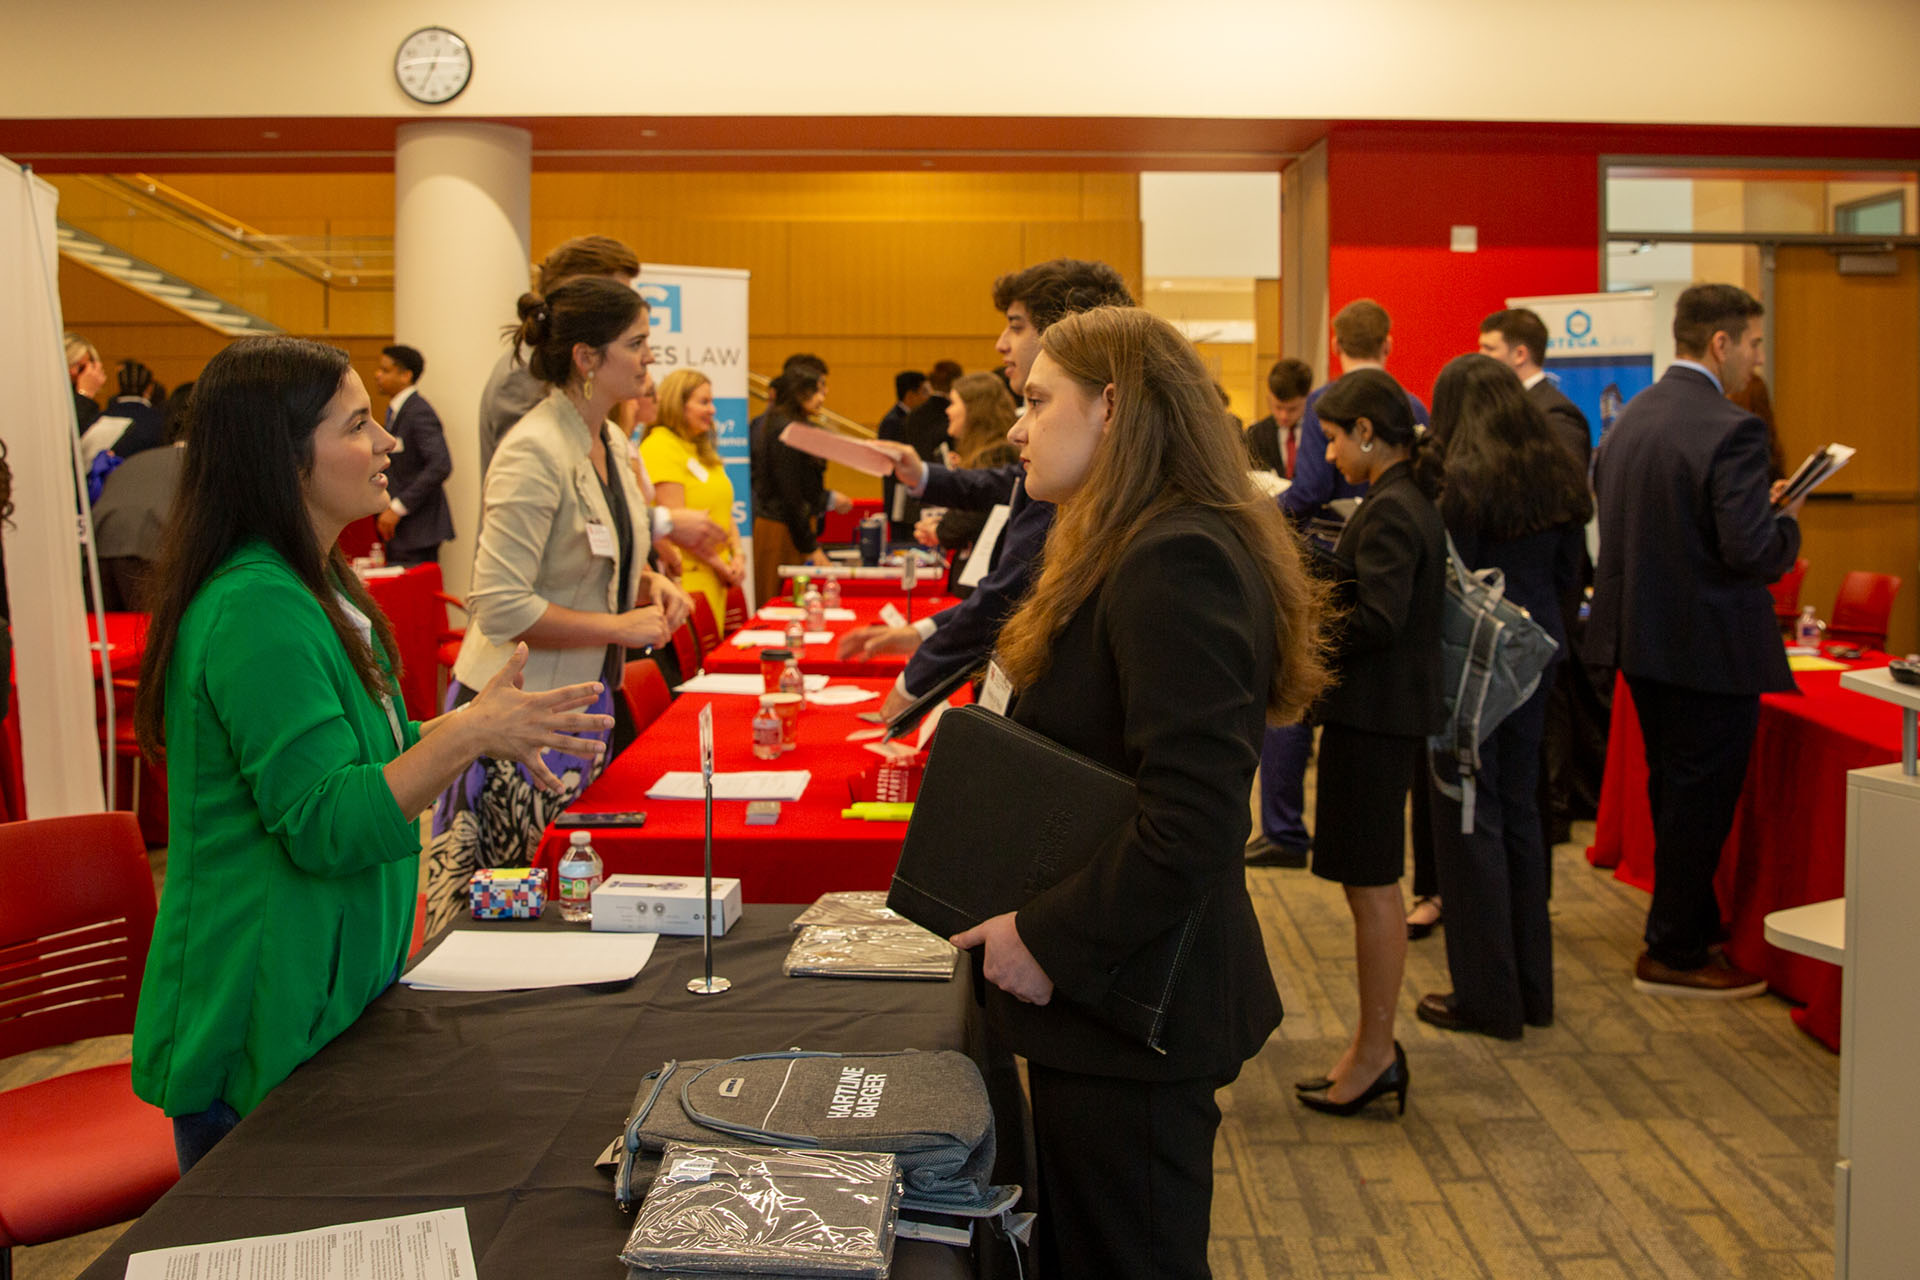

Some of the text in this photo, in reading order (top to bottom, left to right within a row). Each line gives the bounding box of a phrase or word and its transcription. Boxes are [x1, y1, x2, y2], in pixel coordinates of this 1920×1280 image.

[685, 346, 742, 367] LAW
[826, 1066, 865, 1119] HARTLINE
[852, 1073, 888, 1119] BARGER
